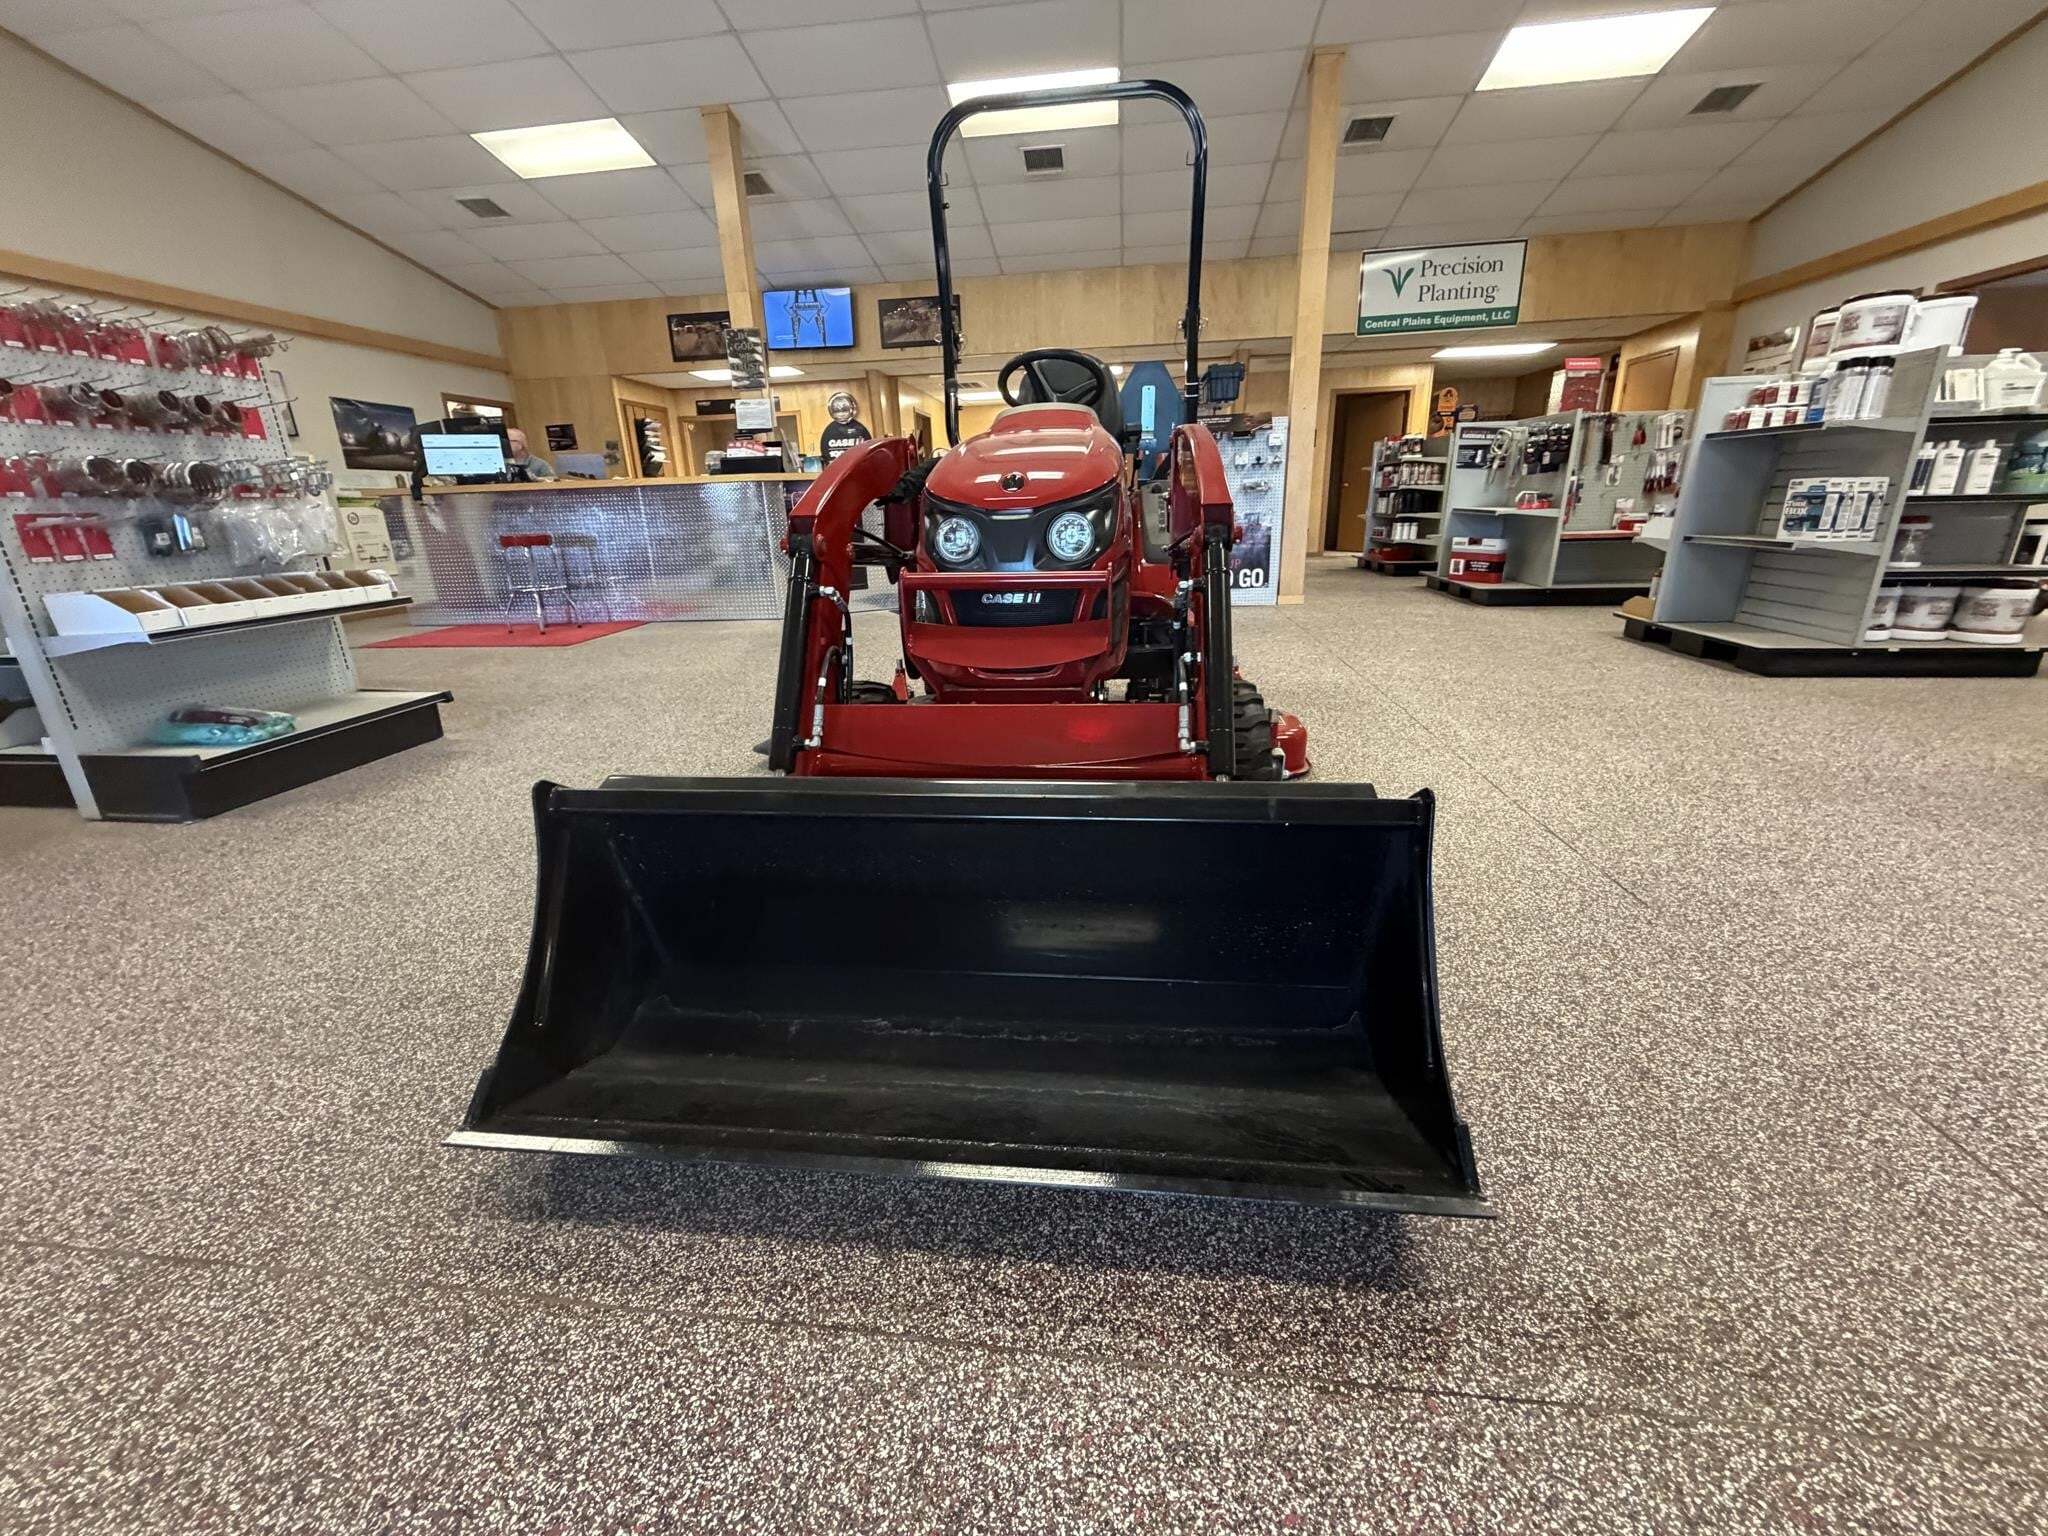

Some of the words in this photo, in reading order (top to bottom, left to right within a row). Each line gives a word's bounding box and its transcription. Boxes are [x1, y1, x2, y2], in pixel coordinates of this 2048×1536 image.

[1421, 256, 1503, 277] Precision
[1418, 281, 1498, 303] Planting
[1364, 317, 1400, 329] Central
[1402, 315, 1432, 327] Plains
[1434, 312, 1489, 325] Equipment,
[1491, 310, 1511, 321] LLC
[828, 438, 855, 447] CASE
[1239, 568, 1264, 588] GO
[981, 593, 1025, 604] CASE
